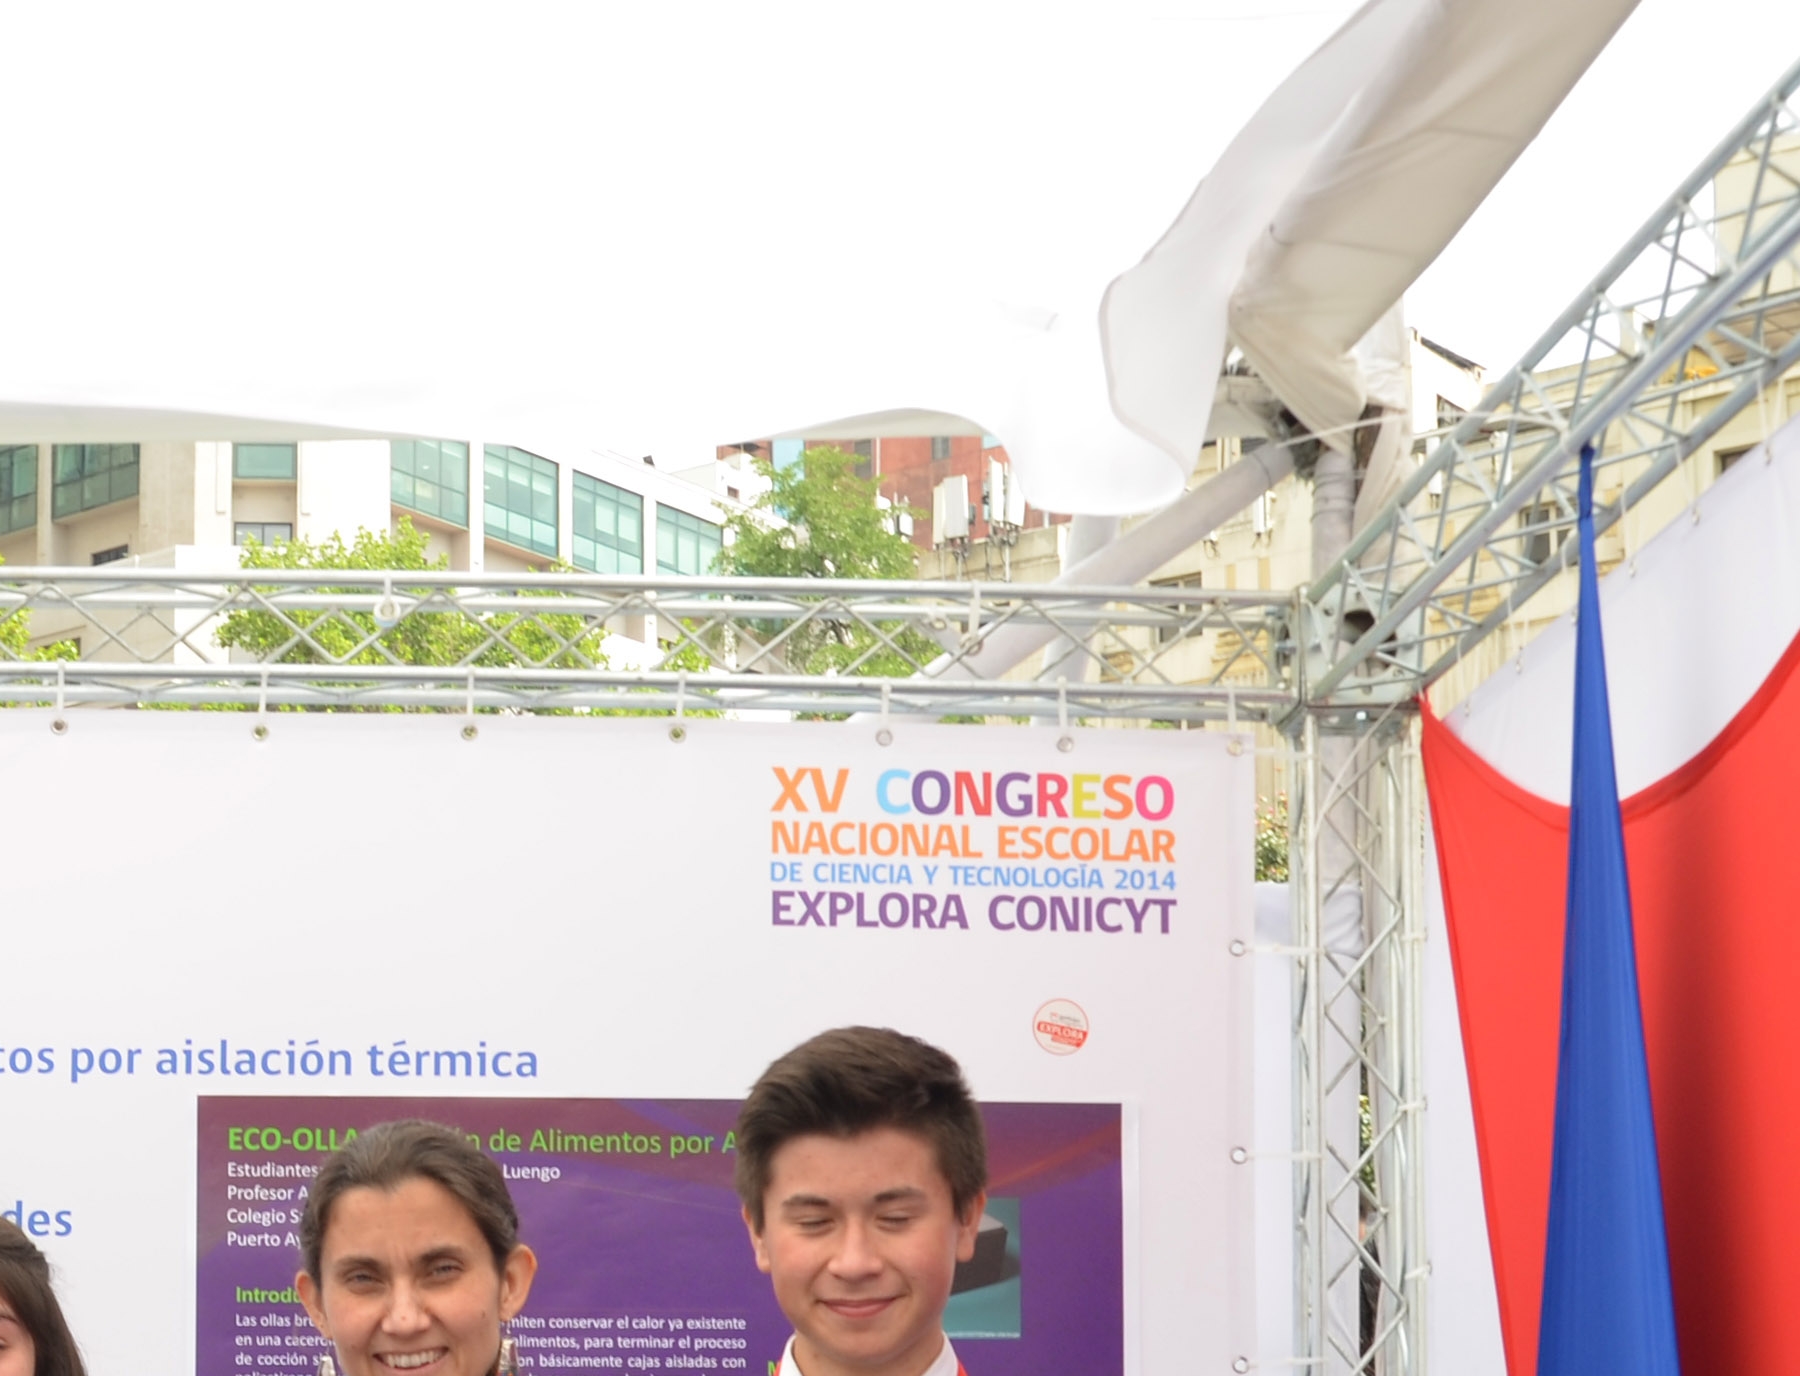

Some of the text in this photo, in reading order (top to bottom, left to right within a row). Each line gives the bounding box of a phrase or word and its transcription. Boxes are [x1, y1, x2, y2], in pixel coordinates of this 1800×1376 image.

[770, 767, 1175, 821] XV CONGRESO
[771, 821, 1176, 864] NACIONAL ESCOLAR
[770, 862, 1177, 890] DE CIENCIA Y TECNOLOGÍA 2014
[771, 890, 1178, 934] EXPLORA CONICYT
[70, 1043, 142, 1083] por
[156, 1038, 354, 1077] aislación
[368, 1038, 539, 1079] térmica
[489, 1128, 521, 1152] de
[530, 1128, 662, 1153] Alimentos
[670, 1134, 715, 1158] por
[503, 1164, 561, 1182] Luengo
[227, 1184, 294, 1200] Profesor
[227, 1207, 286, 1226] Colegio
[227, 1230, 281, 1247] Puerto
[236, 1313, 256, 1327] Las
[260, 1313, 291, 1327] ollas
[548, 1318, 613, 1330] conservar
[616, 1315, 629, 1329] el
[632, 1316, 663, 1330] calor
[668, 1319, 683, 1333] ya
[686, 1317, 746, 1330] existente
[235, 1335, 253, 1346] en
[256, 1335, 281, 1346] una
[584, 1338, 613, 1352] para
[618, 1336, 675, 1349] terminar
[678, 1336, 691, 1349] el
[694, 1338, 746, 1352] proceso
[235, 1353, 253, 1366] de
[257, 1352, 308, 1366] cocción
[539, 1354, 623, 1368] básicamente
[627, 1355, 661, 1371] cajas
[665, 1354, 718, 1369] aisladas
[722, 1357, 746, 1369] con
